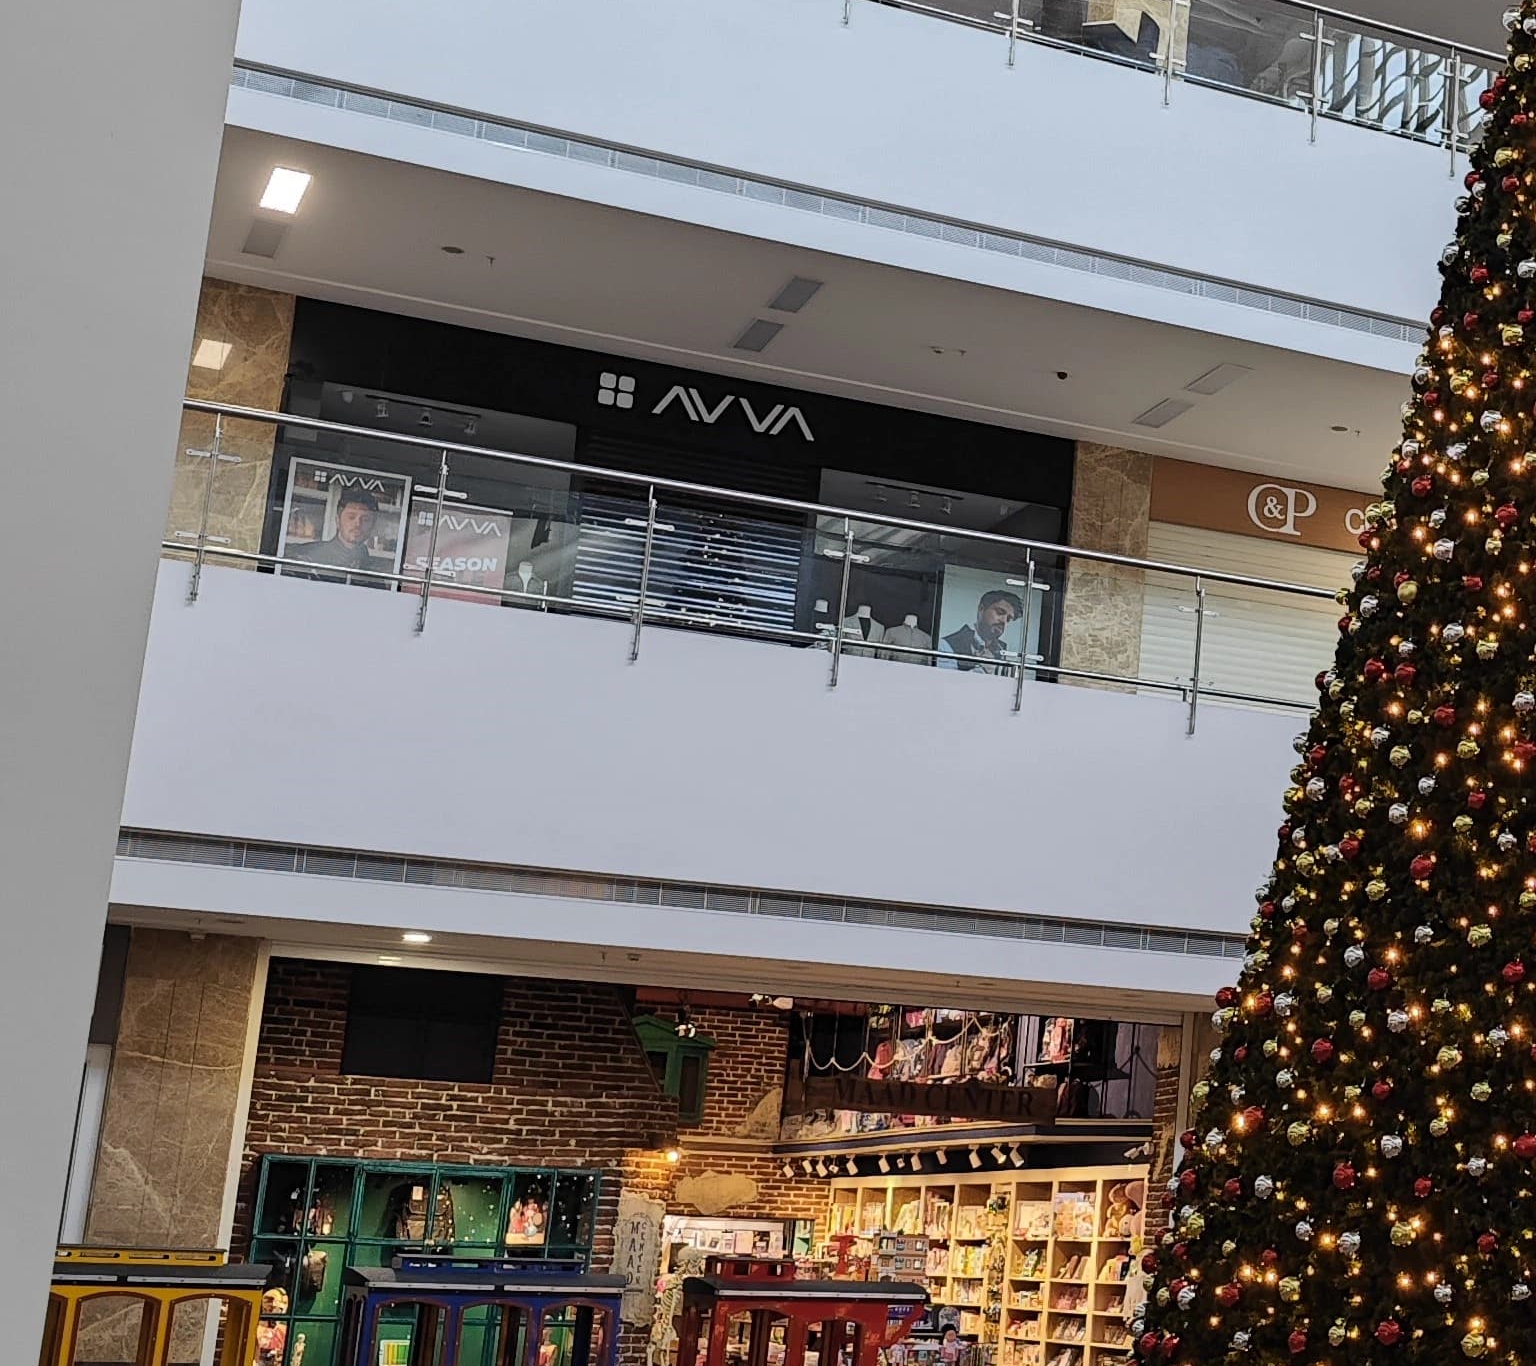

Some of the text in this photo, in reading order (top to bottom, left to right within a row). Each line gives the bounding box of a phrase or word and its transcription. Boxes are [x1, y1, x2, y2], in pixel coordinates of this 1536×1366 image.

[651, 385, 815, 442] AVVA
[329, 473, 385, 493] AVVA
[437, 514, 502, 537] AVVA
[415, 555, 498, 573] SEASON
[924, 1083, 1035, 1118] CENTER
